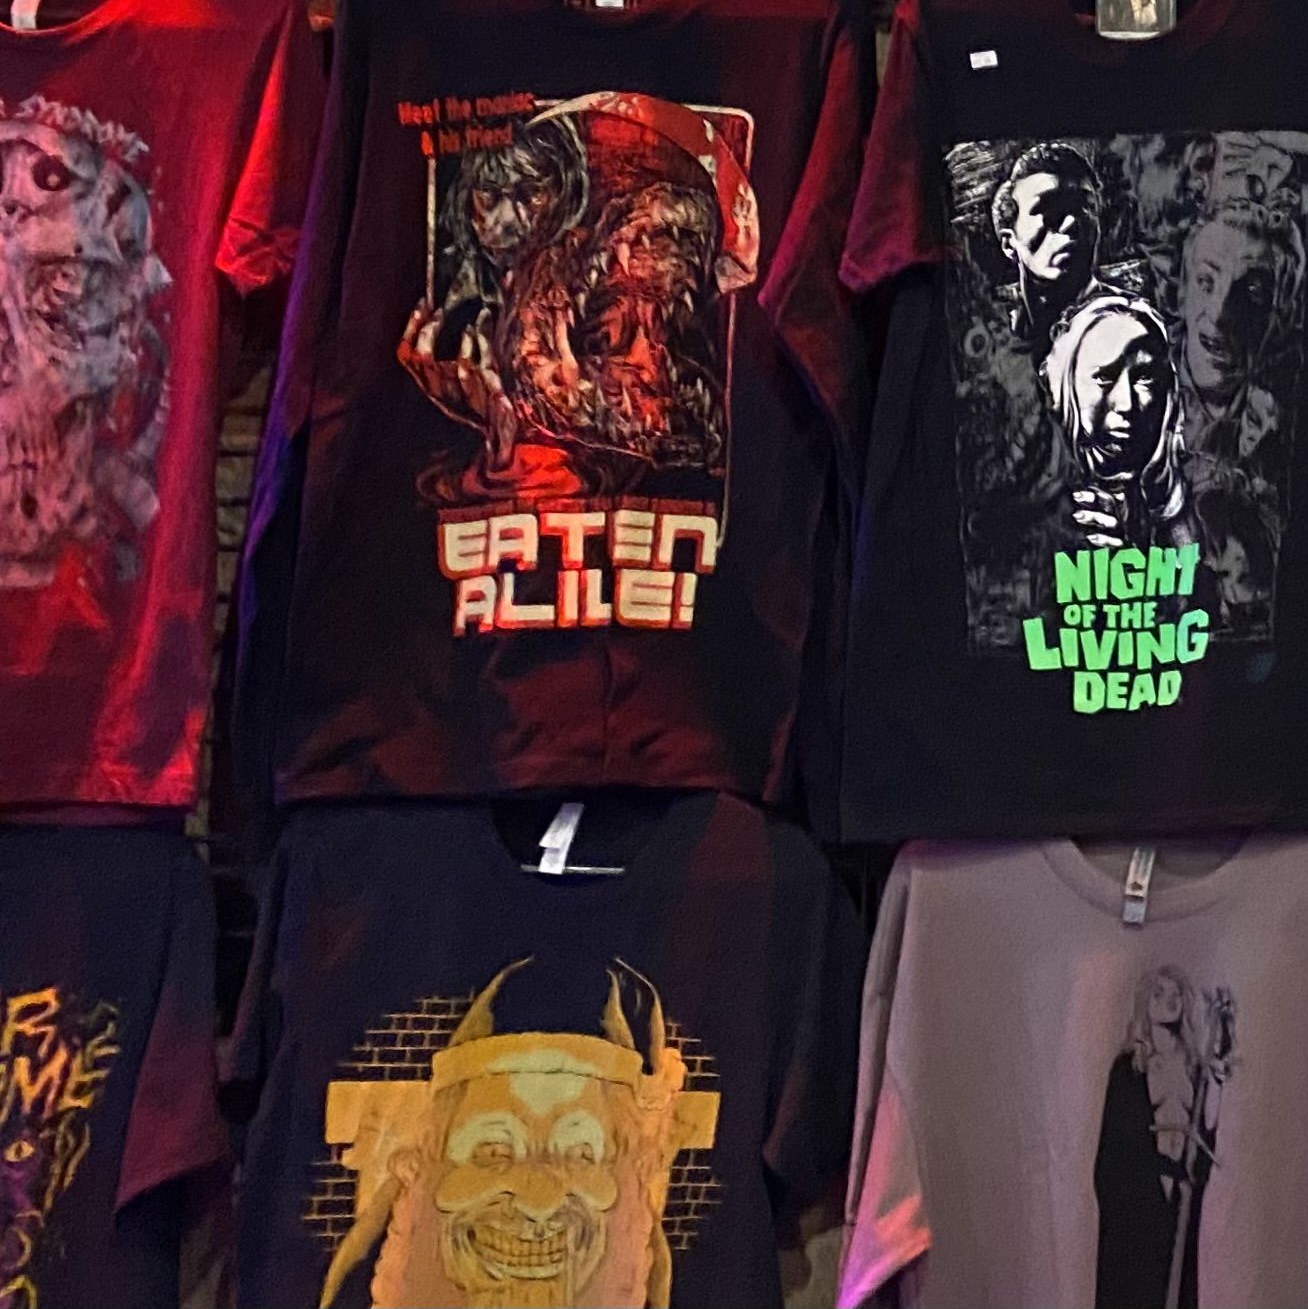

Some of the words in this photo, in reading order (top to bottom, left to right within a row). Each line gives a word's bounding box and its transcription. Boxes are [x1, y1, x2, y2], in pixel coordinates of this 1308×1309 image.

[442, 506, 720, 580] EATEN
[1054, 544, 1200, 604] NIGHT
[1023, 609, 1210, 672] LIVING
[1064, 603, 1097, 628] OF
[1105, 602, 1157, 630] THE
[1073, 670, 1183, 714] DEAD
